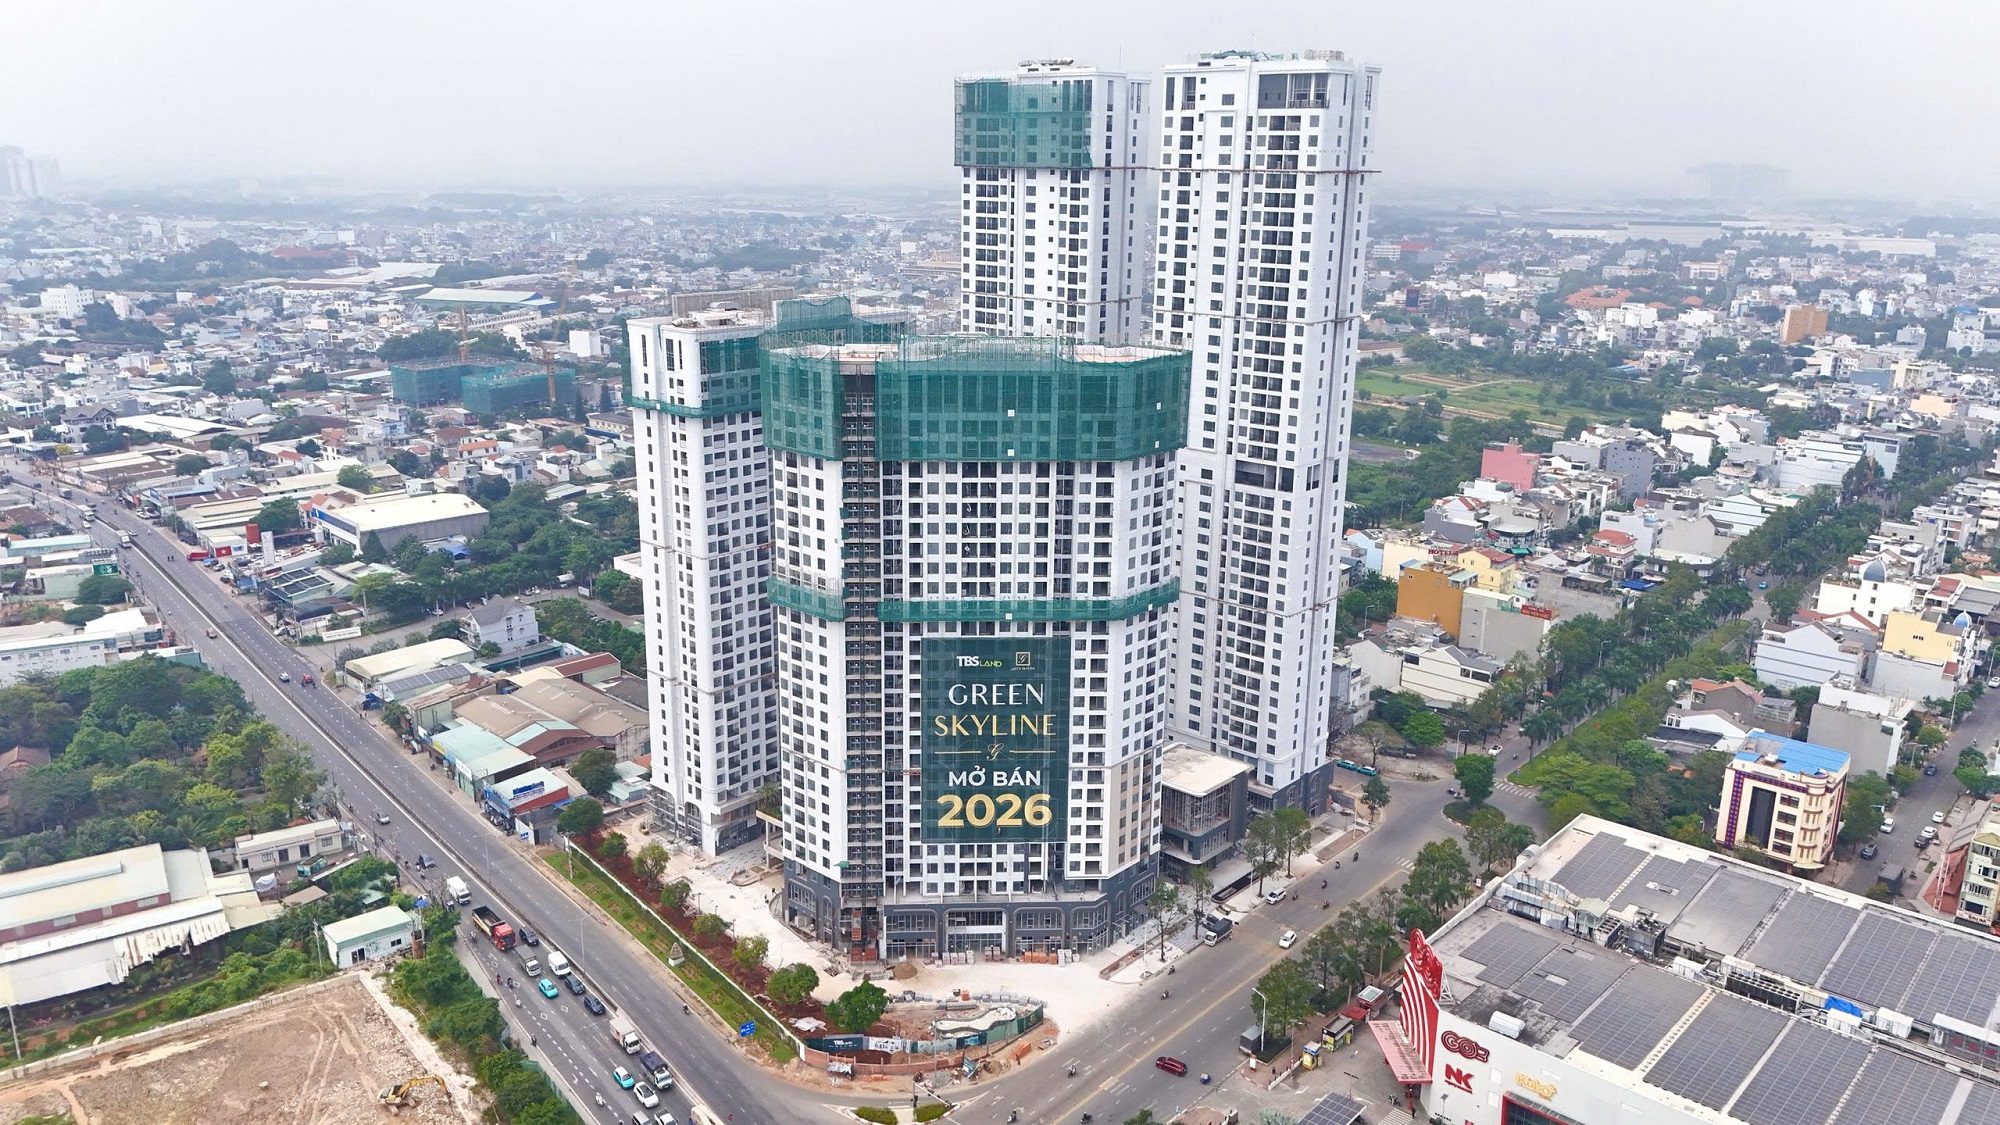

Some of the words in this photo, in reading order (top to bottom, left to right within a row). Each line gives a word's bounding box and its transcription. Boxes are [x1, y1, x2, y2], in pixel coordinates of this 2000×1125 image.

[956, 655, 979, 667] TBS
[948, 683, 1043, 705] GREEN
[934, 714, 1056, 736] SKYLINE
[948, 765, 986, 787] MỞ
[992, 766, 1041, 787] BÁN
[937, 793, 1053, 828] 2026
[1444, 1063, 1474, 1090] NK
